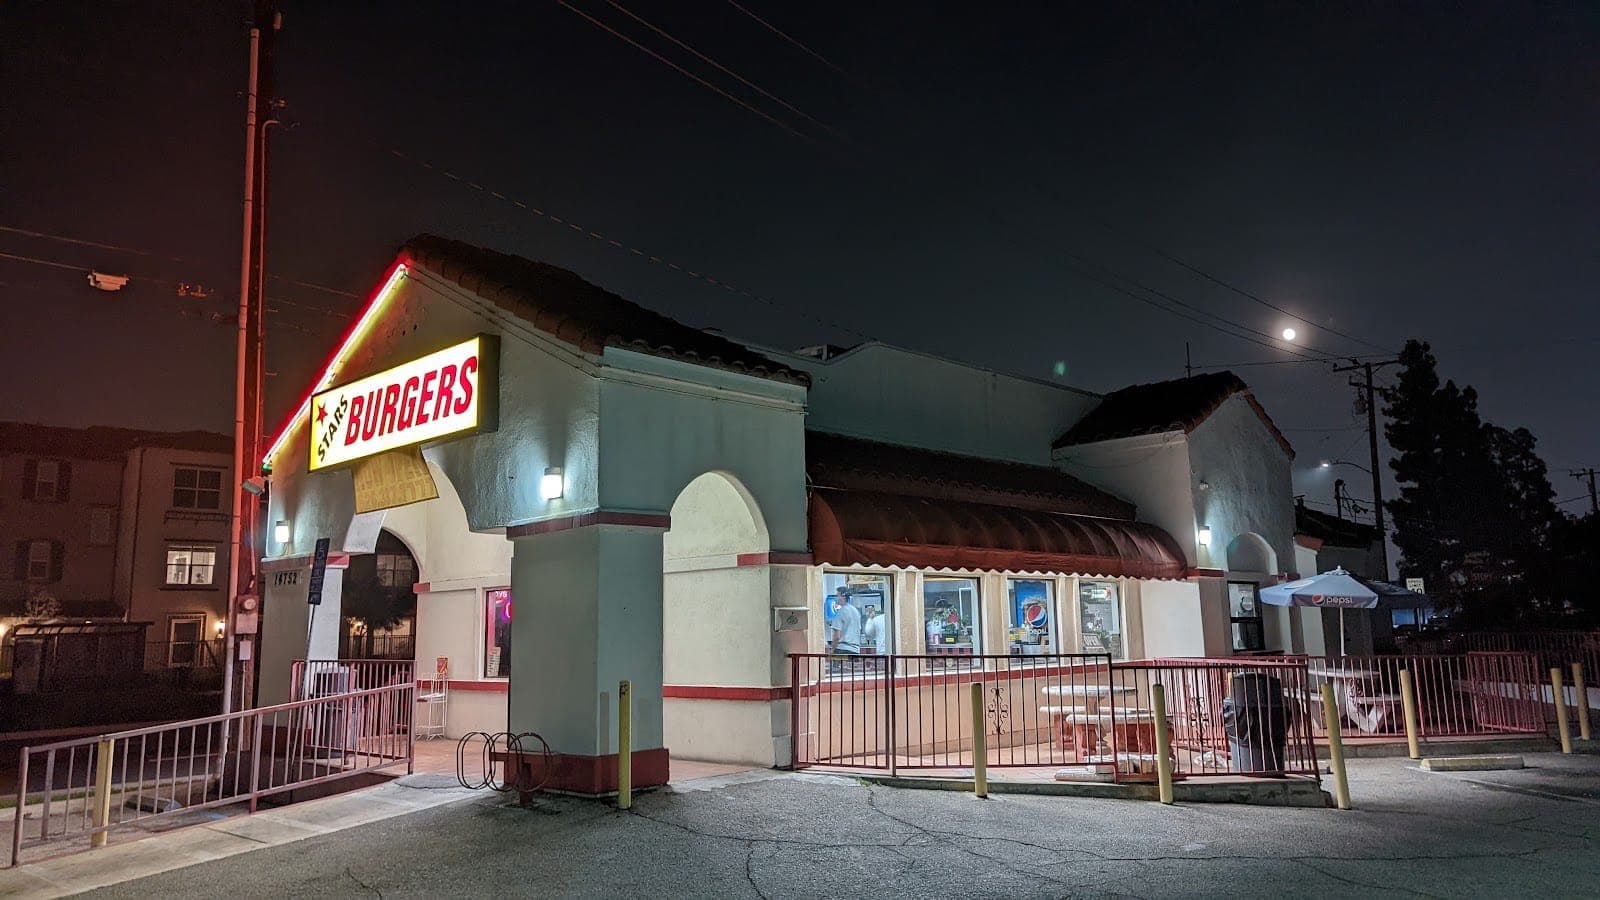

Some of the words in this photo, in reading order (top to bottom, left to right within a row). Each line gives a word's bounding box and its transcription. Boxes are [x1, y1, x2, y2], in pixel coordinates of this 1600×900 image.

[317, 394, 349, 462] STARS
[344, 356, 478, 446] BURGERS
[1326, 596, 1352, 605] pepsi
